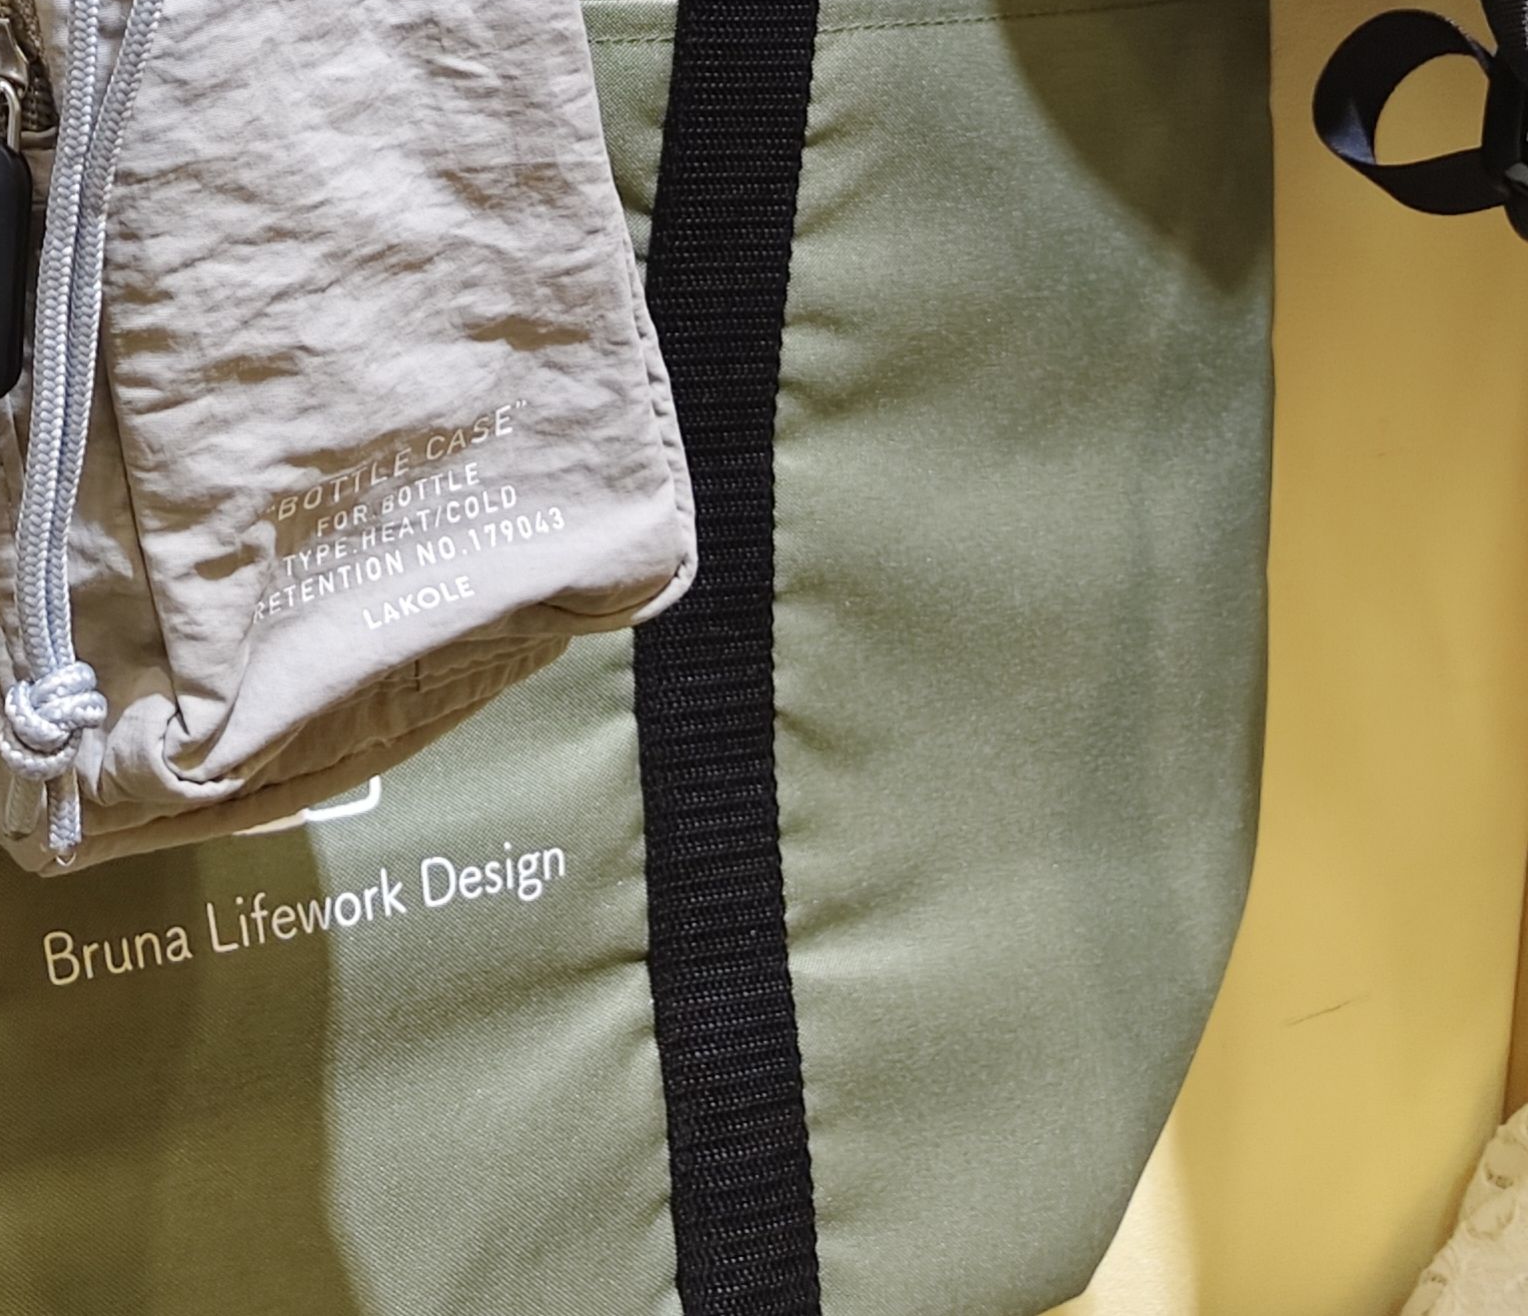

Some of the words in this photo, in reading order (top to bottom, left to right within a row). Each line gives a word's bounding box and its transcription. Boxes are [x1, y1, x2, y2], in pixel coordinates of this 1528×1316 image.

[252, 549, 405, 625] RETENTION
[362, 575, 475, 630] LAKOLE
[43, 924, 193, 986] Bruna
[206, 868, 407, 953] Lifework
[420, 841, 566, 908] Design
